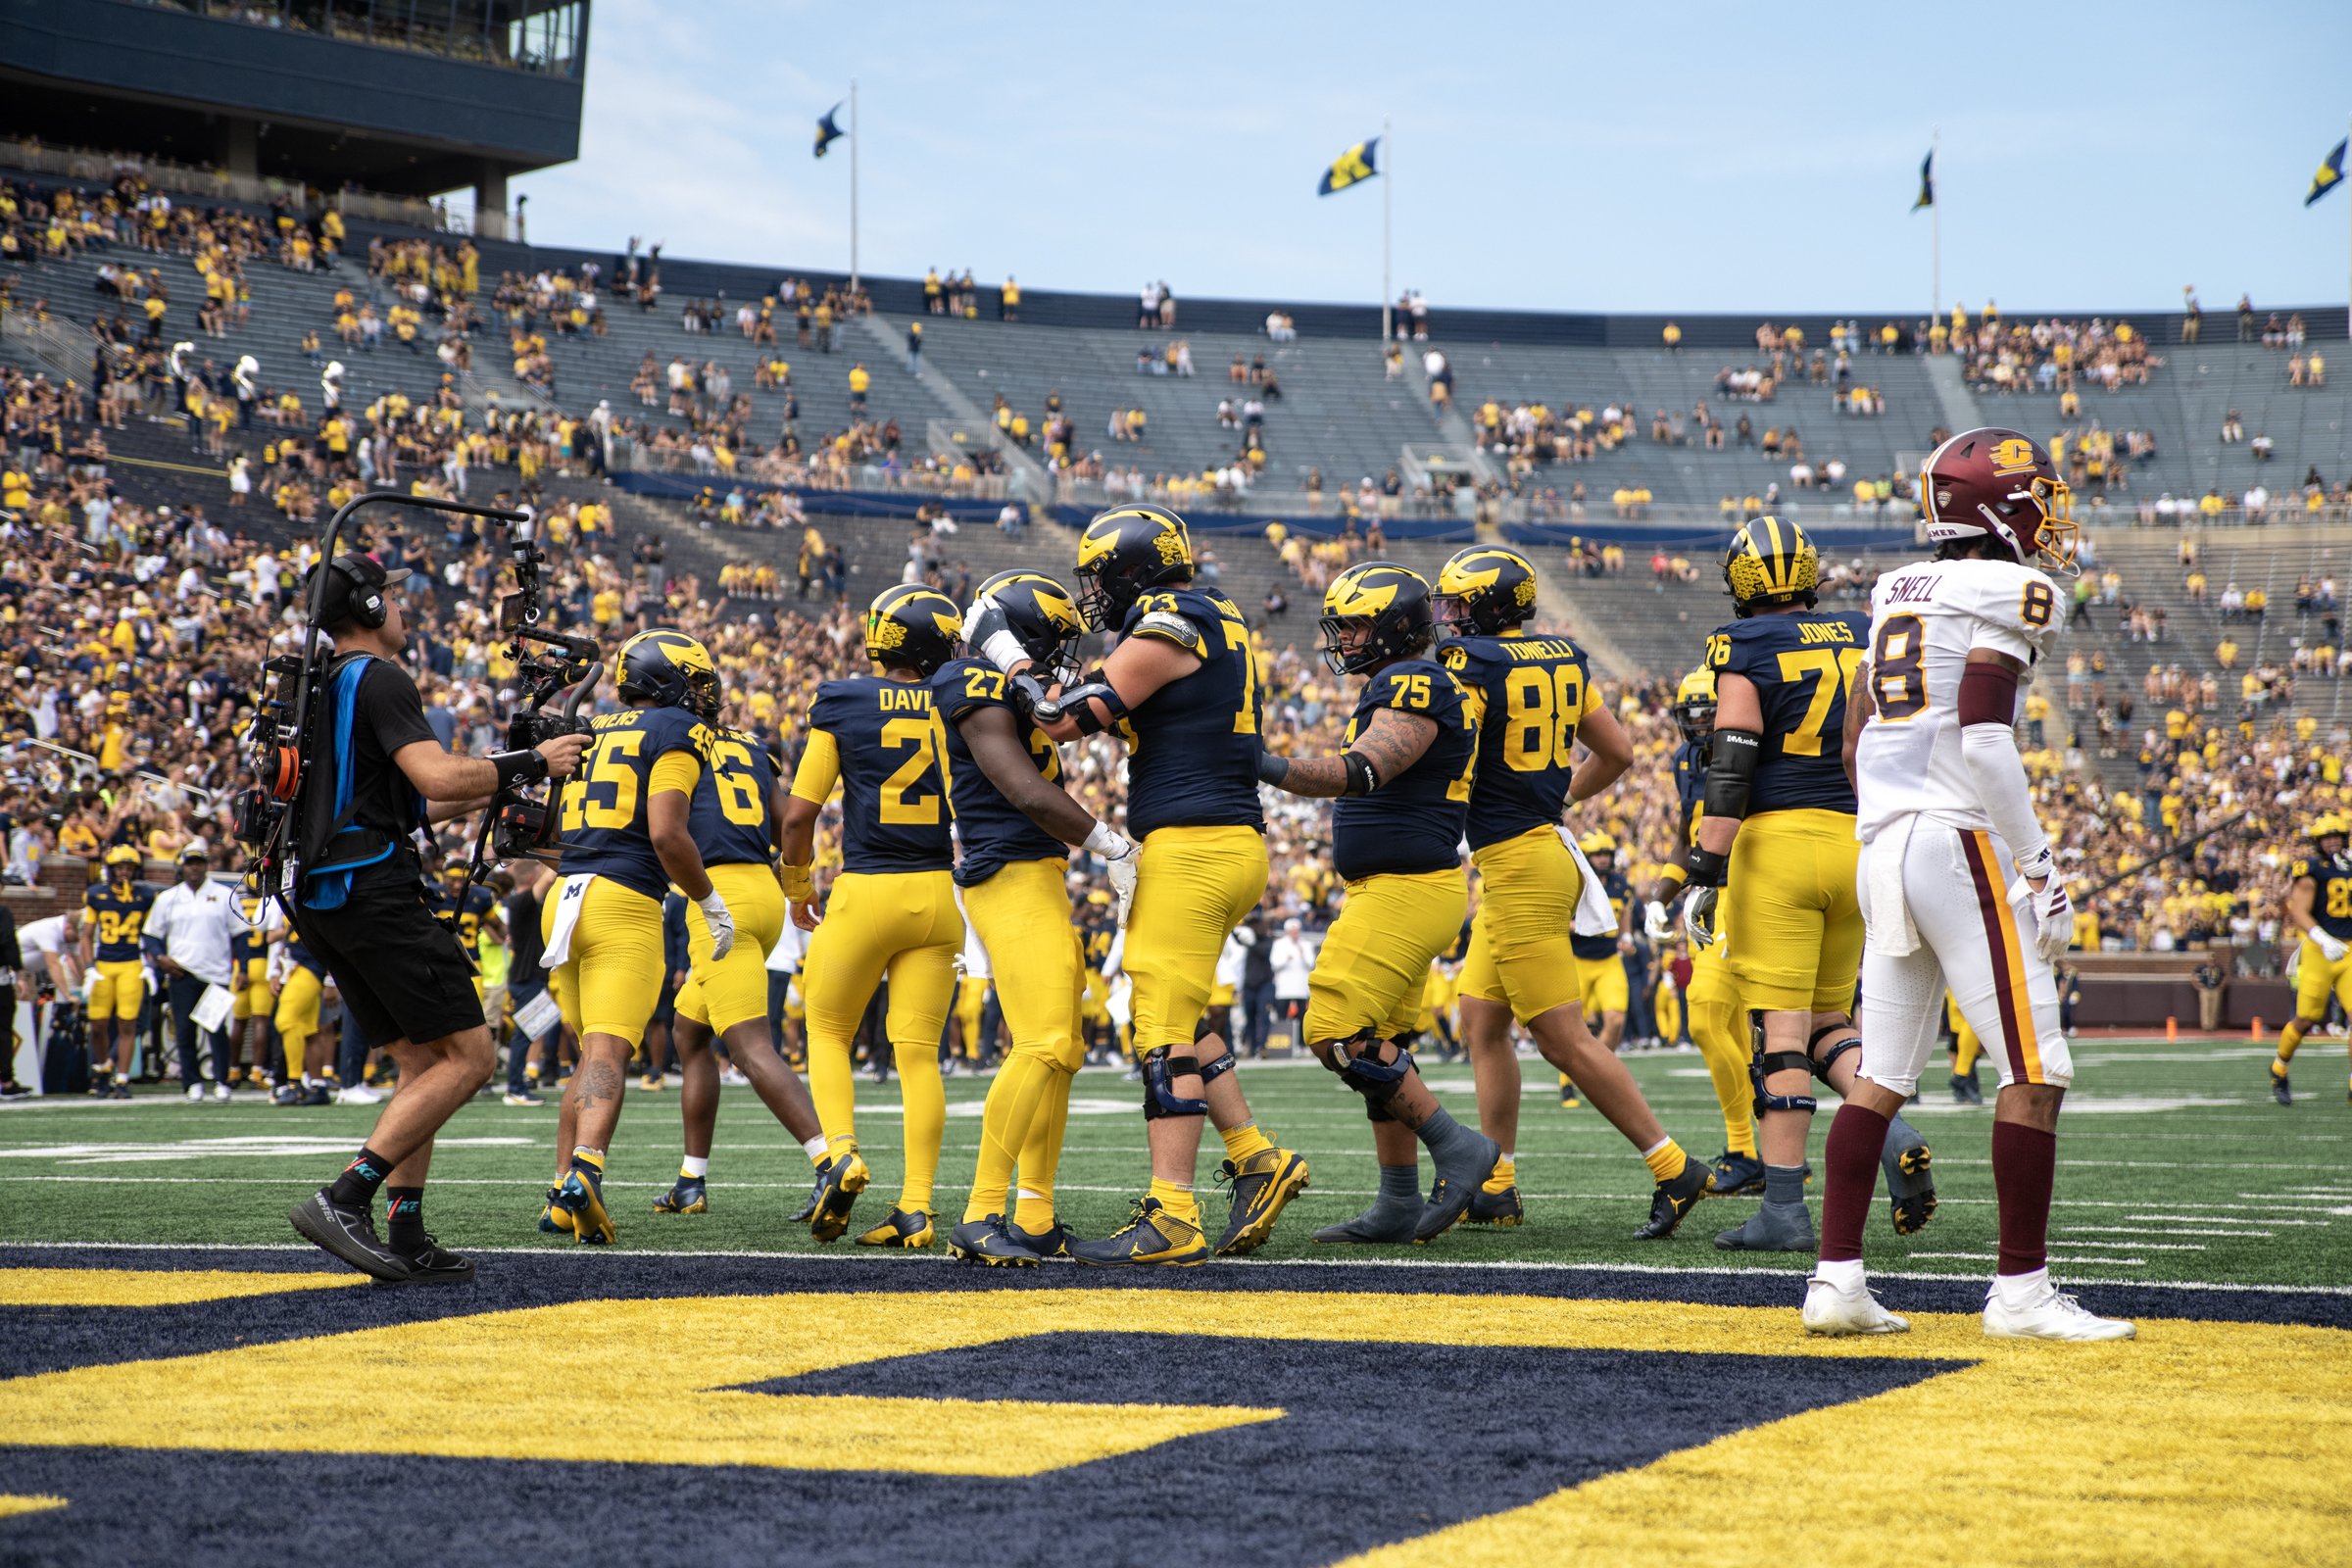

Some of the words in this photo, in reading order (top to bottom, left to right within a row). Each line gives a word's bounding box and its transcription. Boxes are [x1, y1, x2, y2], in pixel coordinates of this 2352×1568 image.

[1136, 594, 1179, 614] 73
[1886, 576, 1942, 605] SNELL
[2020, 580, 2054, 628] 8
[1796, 621, 1855, 644] JONES
[1498, 641, 1575, 662] TONIELLI
[1868, 612, 1930, 723] 8
[879, 688, 932, 712] DAVI
[963, 667, 1005, 700] 27
[1391, 675, 1431, 709] 75
[1504, 663, 1587, 772] 88
[710, 740, 764, 827] 6
[880, 717, 940, 825] 2
[564, 882, 583, 901] M
[2327, 877, 2352, 918] 8
[99, 910, 142, 945] 84
